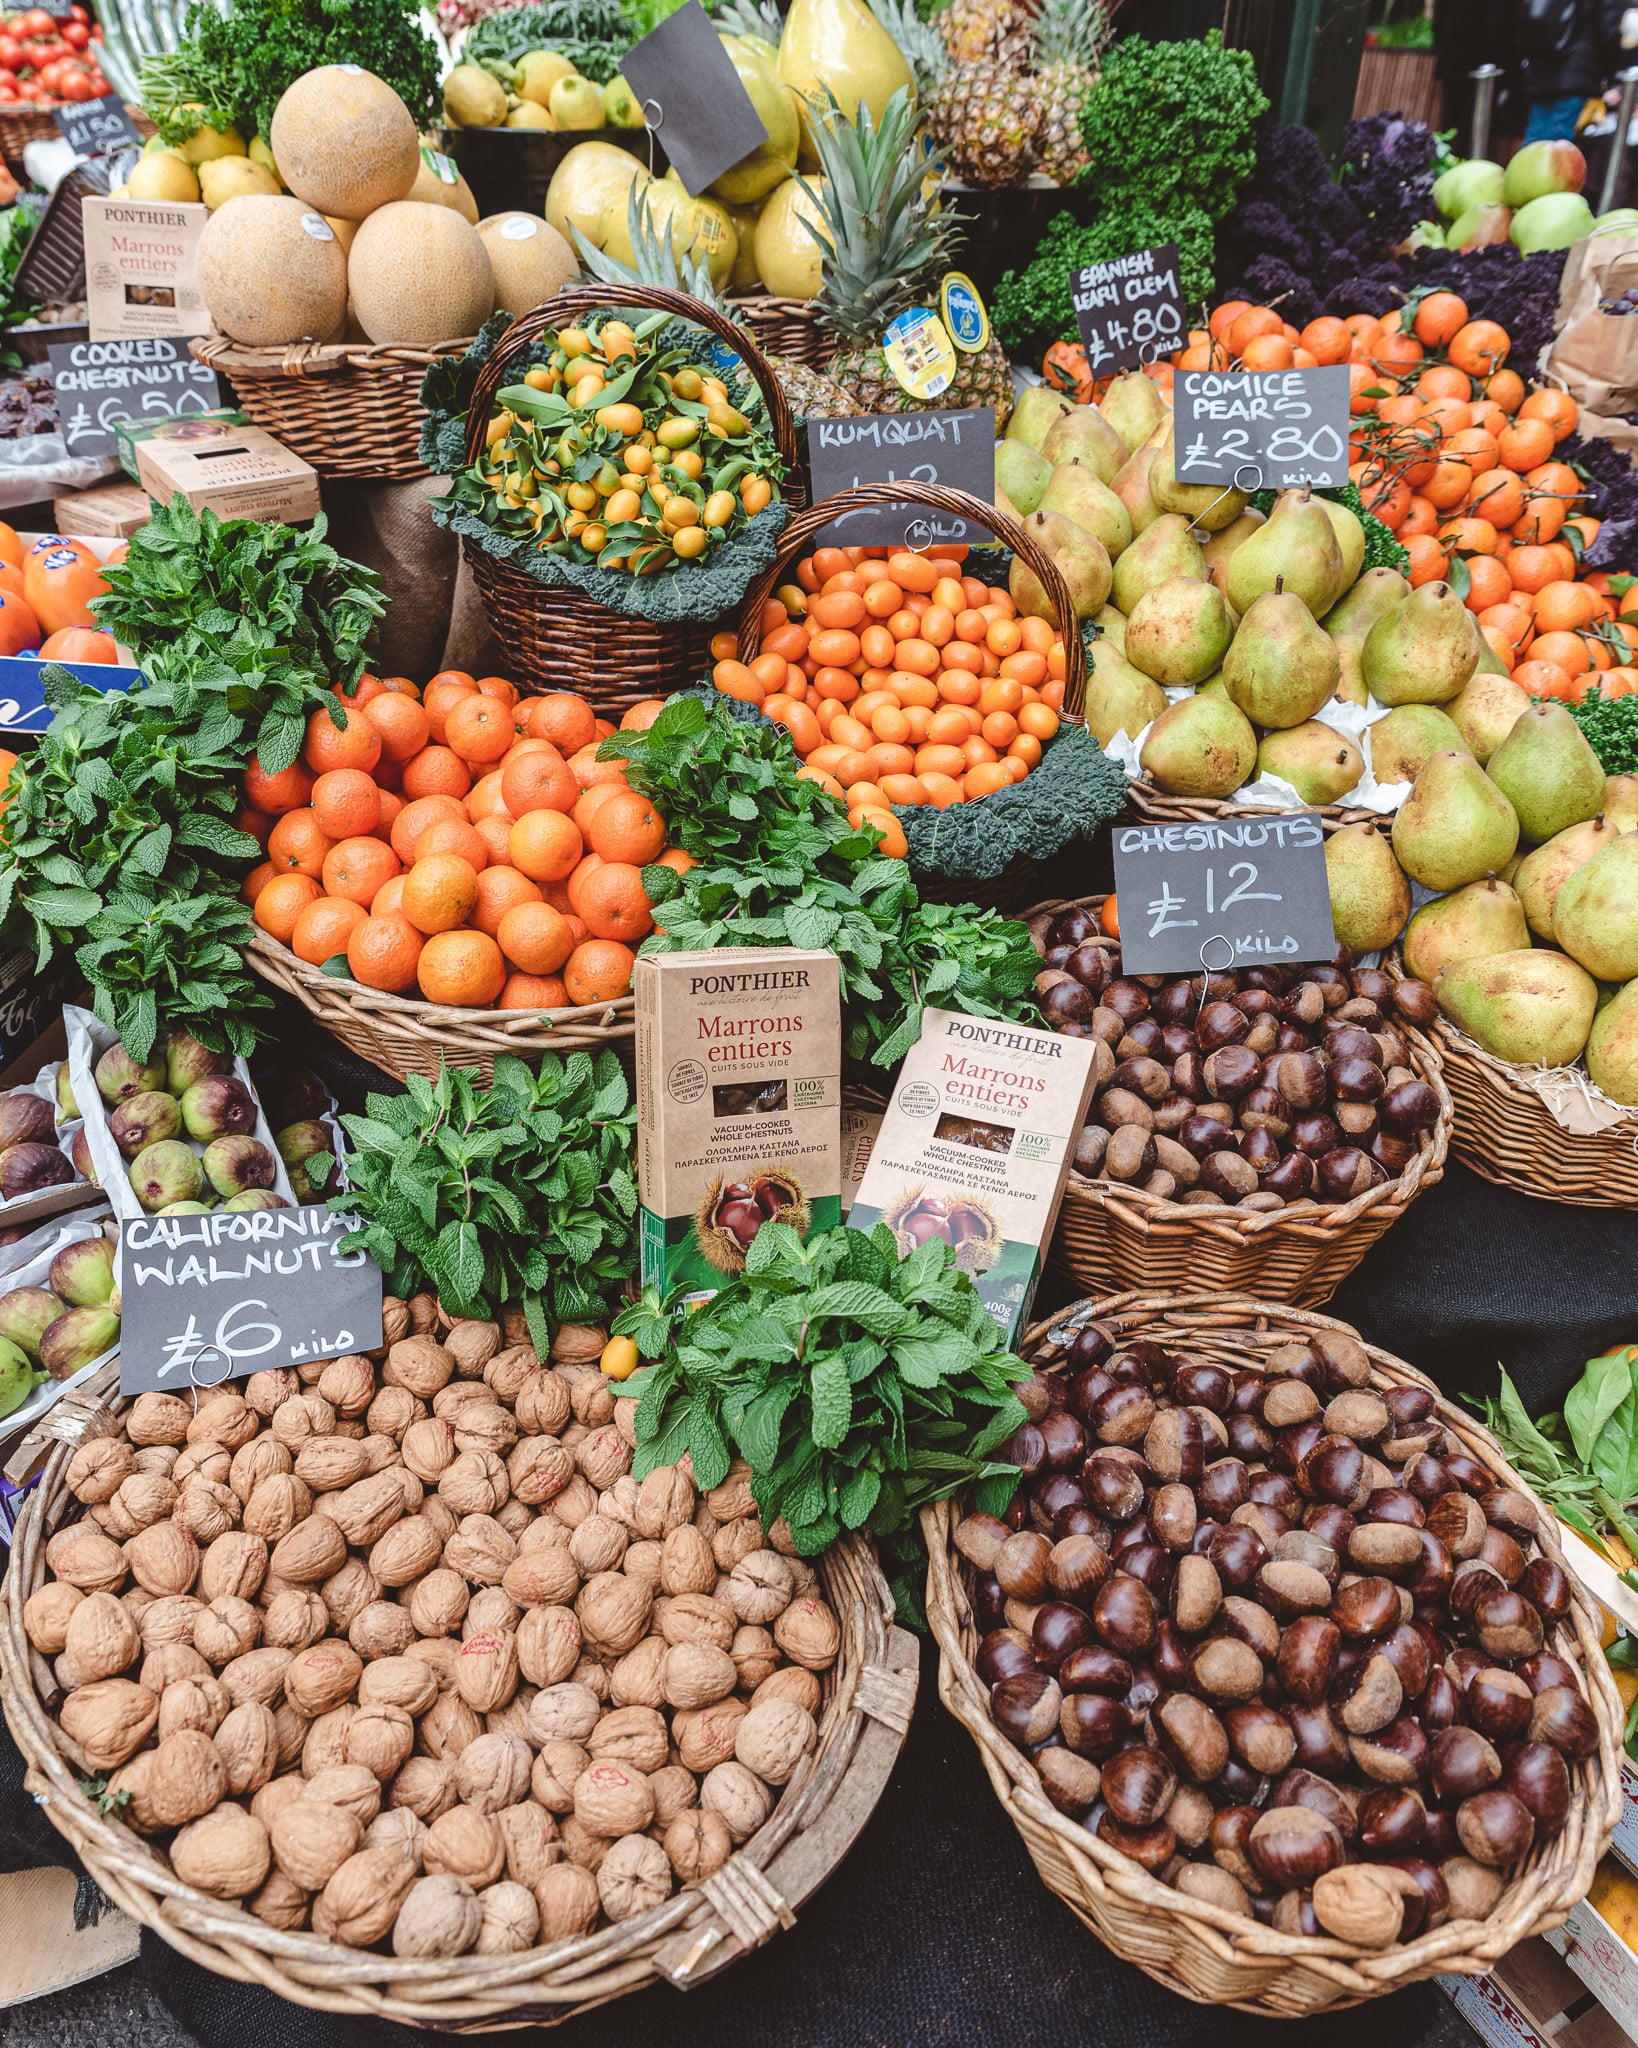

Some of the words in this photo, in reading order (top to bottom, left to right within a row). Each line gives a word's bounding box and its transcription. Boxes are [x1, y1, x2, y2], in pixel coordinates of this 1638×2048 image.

[104, 207, 187, 227] PONTHIER
[111, 236, 185, 256] Marrons
[119, 256, 178, 273] entiers
[1079, 250, 1155, 289] SPANISH
[1073, 283, 1121, 312] LEAFY
[1124, 269, 1179, 301] CLEM
[1089, 302, 1182, 369] £4.80
[70, 339, 178, 367] COOKED
[55, 361, 215, 391] CHESTNUTS
[1184, 372, 1307, 398] COMICE
[1193, 397, 1313, 421] PEARS
[819, 412, 976, 449] KUMQUAT
[1180, 424, 1344, 471] £2.80
[255, 496, 292, 508] Marrons
[1119, 818, 1324, 853] CHESTNUTS
[1147, 862, 1283, 938] £12
[689, 970, 811, 995] PONTHIER
[696, 1014, 804, 1040] Marrons
[945, 1021, 1063, 1058] PONTHIER
[708, 1036, 793, 1063] entiers
[711, 1063, 738, 1073] CUITS
[740, 1061, 765, 1070] SOUS
[768, 1059, 790, 1068] VIDE
[940, 1053, 1047, 1092] Marrons
[794, 1079, 825, 1093] 100%
[945, 1079, 1030, 1110] entiers
[944, 1095, 971, 1107] CUITS
[973, 1101, 999, 1113] SOUS
[1001, 1108, 1023, 1118] VIDE
[710, 1132, 743, 1143] WHOLE
[744, 1127, 793, 1140] CHESTNUTS
[714, 1119, 791, 1134] VACUUM-COOKED
[706, 1144, 757, 1157] ΟΛΟΚΛΗΡΑ
[759, 1139, 800, 1151] ΚΑΣΤΑΝΑ
[1020, 1133, 1053, 1147] 100%
[674, 1153, 760, 1169] ΠΑΡΑΣΚΕΥΑΣΜΕΝΑ
[762, 1150, 774, 1159] ΣΕ
[775, 1148, 799, 1158] ΚΕΝΟ
[800, 1144, 829, 1154] ΑΕΡΟΣ
[923, 1150, 955, 1164] WHOLE
[956, 1158, 1007, 1175] CHESTNUTS
[929, 1144, 1006, 1168] VACUUM-COOKED
[880, 1159, 965, 1186] ΠΑΡΑΣΚΕΥΑΣΜΕΝΑ
[967, 1181, 979, 1189] ΣΕ
[980, 1183, 1006, 1195] ΚΕΝΟ
[1007, 1190, 1038, 1201] ΑΕΡΟΣ
[914, 1160, 965, 1178] ΟΛΟΚΛΗΡΑ
[966, 1171, 1009, 1188] ΚΑΣΤΑΝΑ
[126, 1209, 365, 1251] CALIFORNIA
[133, 1236, 367, 1287] WALNUTS
[676, 1306, 684, 1317] A
[983, 1301, 1013, 1318] 400g
[157, 1299, 282, 1378] £6
